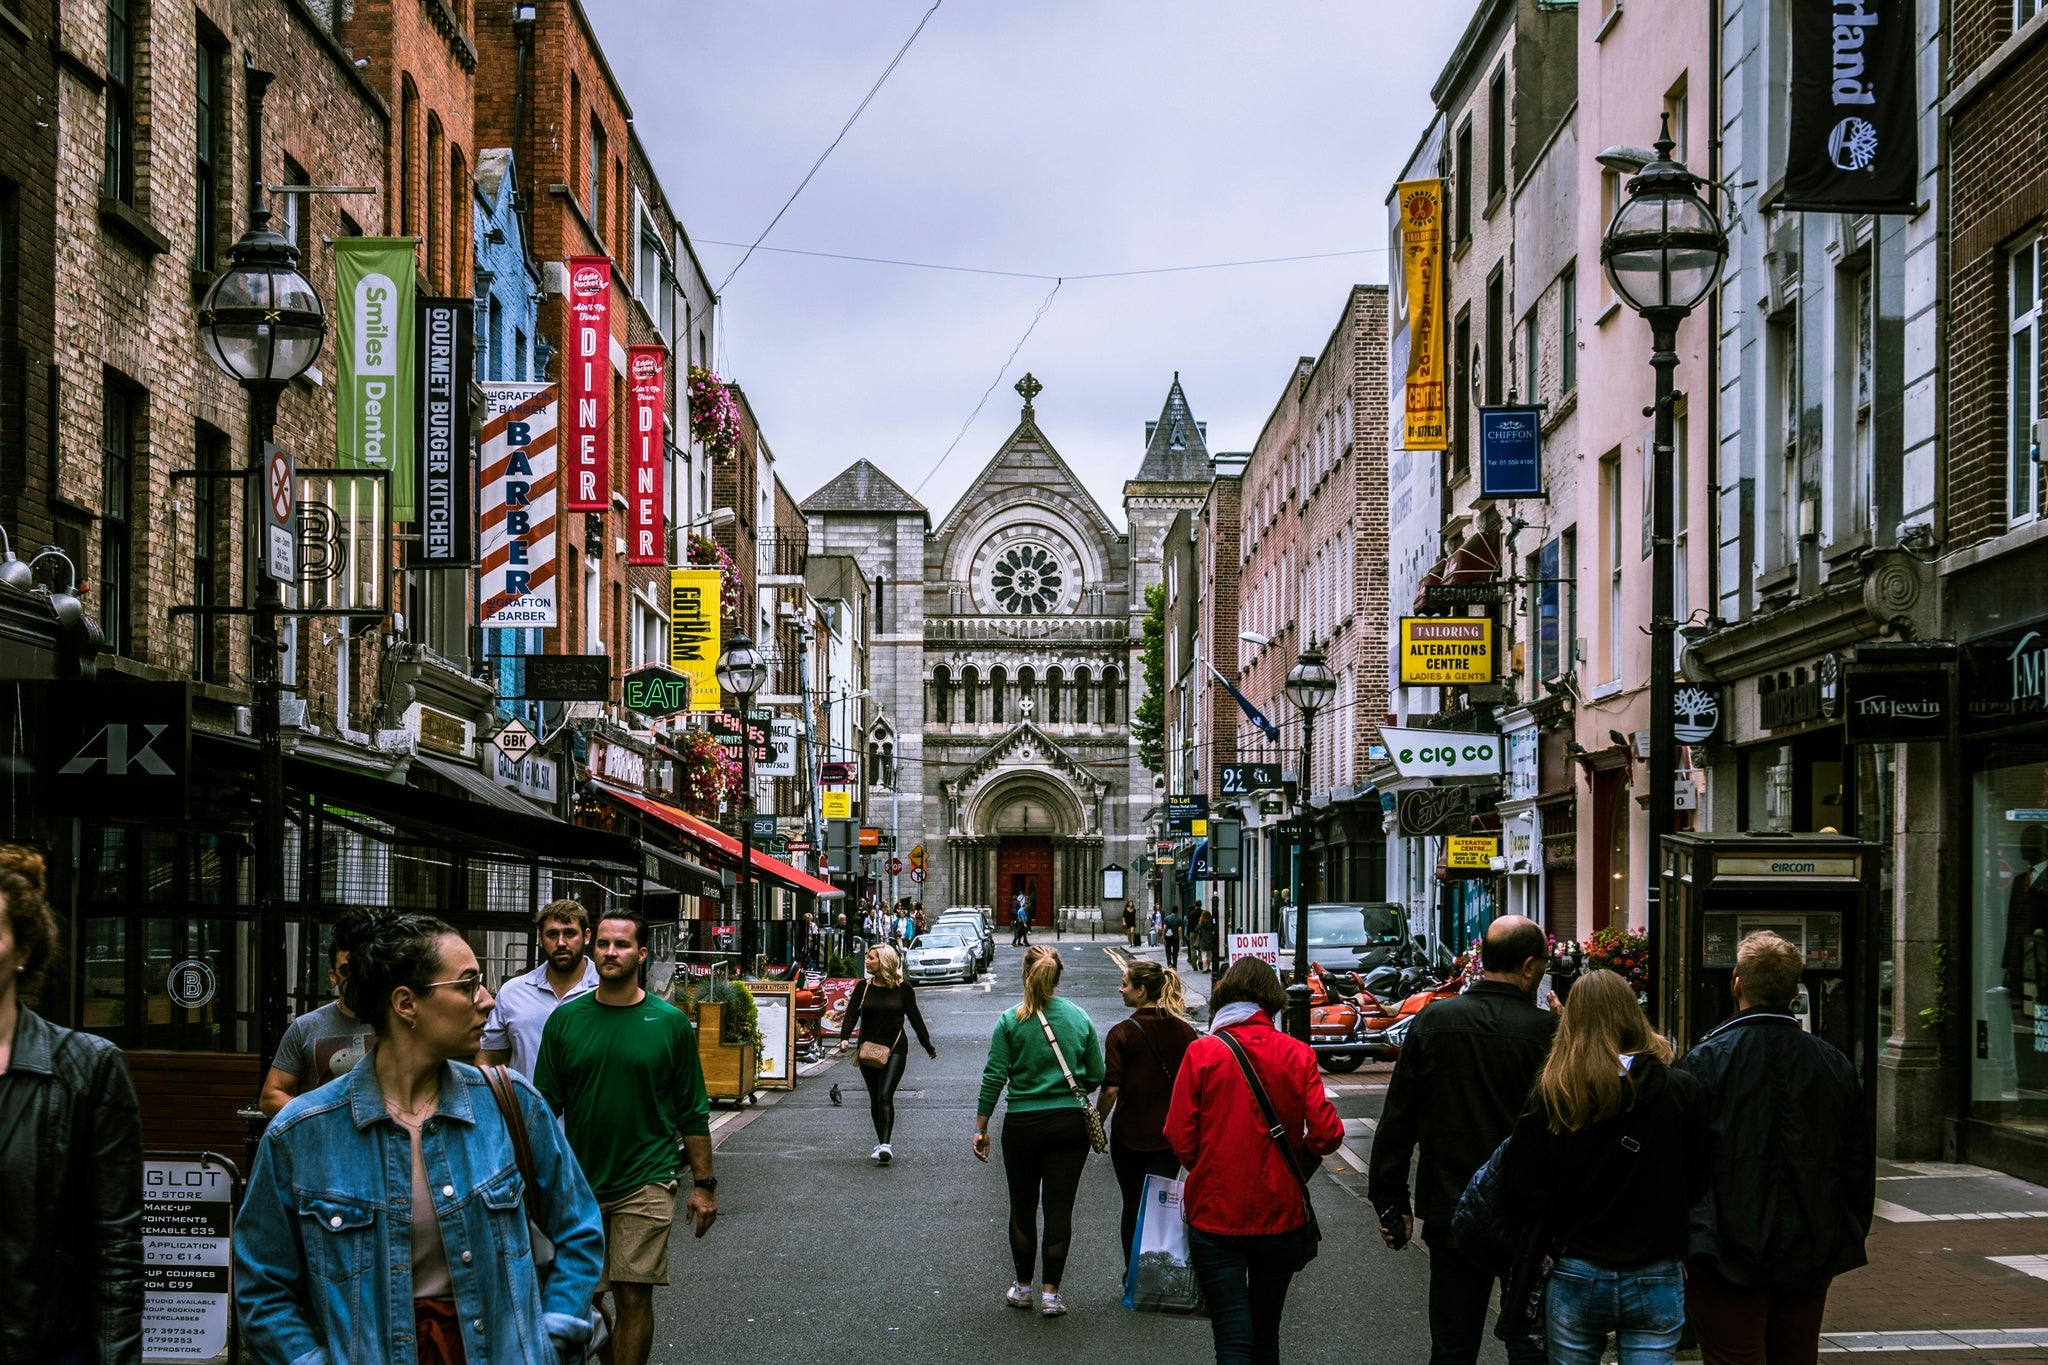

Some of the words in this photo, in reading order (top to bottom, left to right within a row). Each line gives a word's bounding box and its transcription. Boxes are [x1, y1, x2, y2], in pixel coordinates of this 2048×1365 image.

[578, 273, 598, 281] Eddie
[1419, 257, 1431, 377] ALTERATION
[366, 288, 387, 366] Smiles
[430, 308, 450, 398] GOURMET
[498, 391, 552, 402] GRAFTON
[1409, 387, 1441, 408] CENTRE
[500, 405, 547, 414] BARBER
[580, 328, 596, 500] DINER
[366, 382, 387, 467] Dental
[430, 401, 450, 473] BURGER
[1488, 430, 1533, 439] CHIFFON
[638, 407, 653, 555] DINER
[505, 421, 533, 595] BARBER
[430, 475, 450, 558] KITCHEN
[497, 599, 551, 608] GRAFTON
[498, 612, 546, 621] BARBER
[673, 587, 714, 660] GOTHAM
[1416, 626, 1479, 637] TAILORING
[1410, 644, 1486, 655] ALTERATIONS
[534, 663, 602, 675] GRAFTON
[1426, 658, 1469, 669] CENTRE
[1410, 672, 1442, 680] LADIES
[1445, 672, 1451, 680] &
[1454, 672, 1485, 680] GENTS
[537, 679, 598, 691] BARBER
[627, 678, 684, 709] EAT
[503, 735, 527, 747] GBK
[1399, 749, 1413, 763] e
[1419, 747, 1456, 767] cig
[1462, 745, 1493, 761] co
[753, 823, 773, 832] SO
[1237, 937, 1249, 948] DO
[1251, 936, 1268, 948] NOT
[147, 1171, 221, 1186] GLOT
[144, 1203, 191, 1211] MAKE-UP
[190, 1227, 215, 1235] €35
[149, 1241, 217, 1249] APPLICATION
[166, 1270, 215, 1278] COURSES
